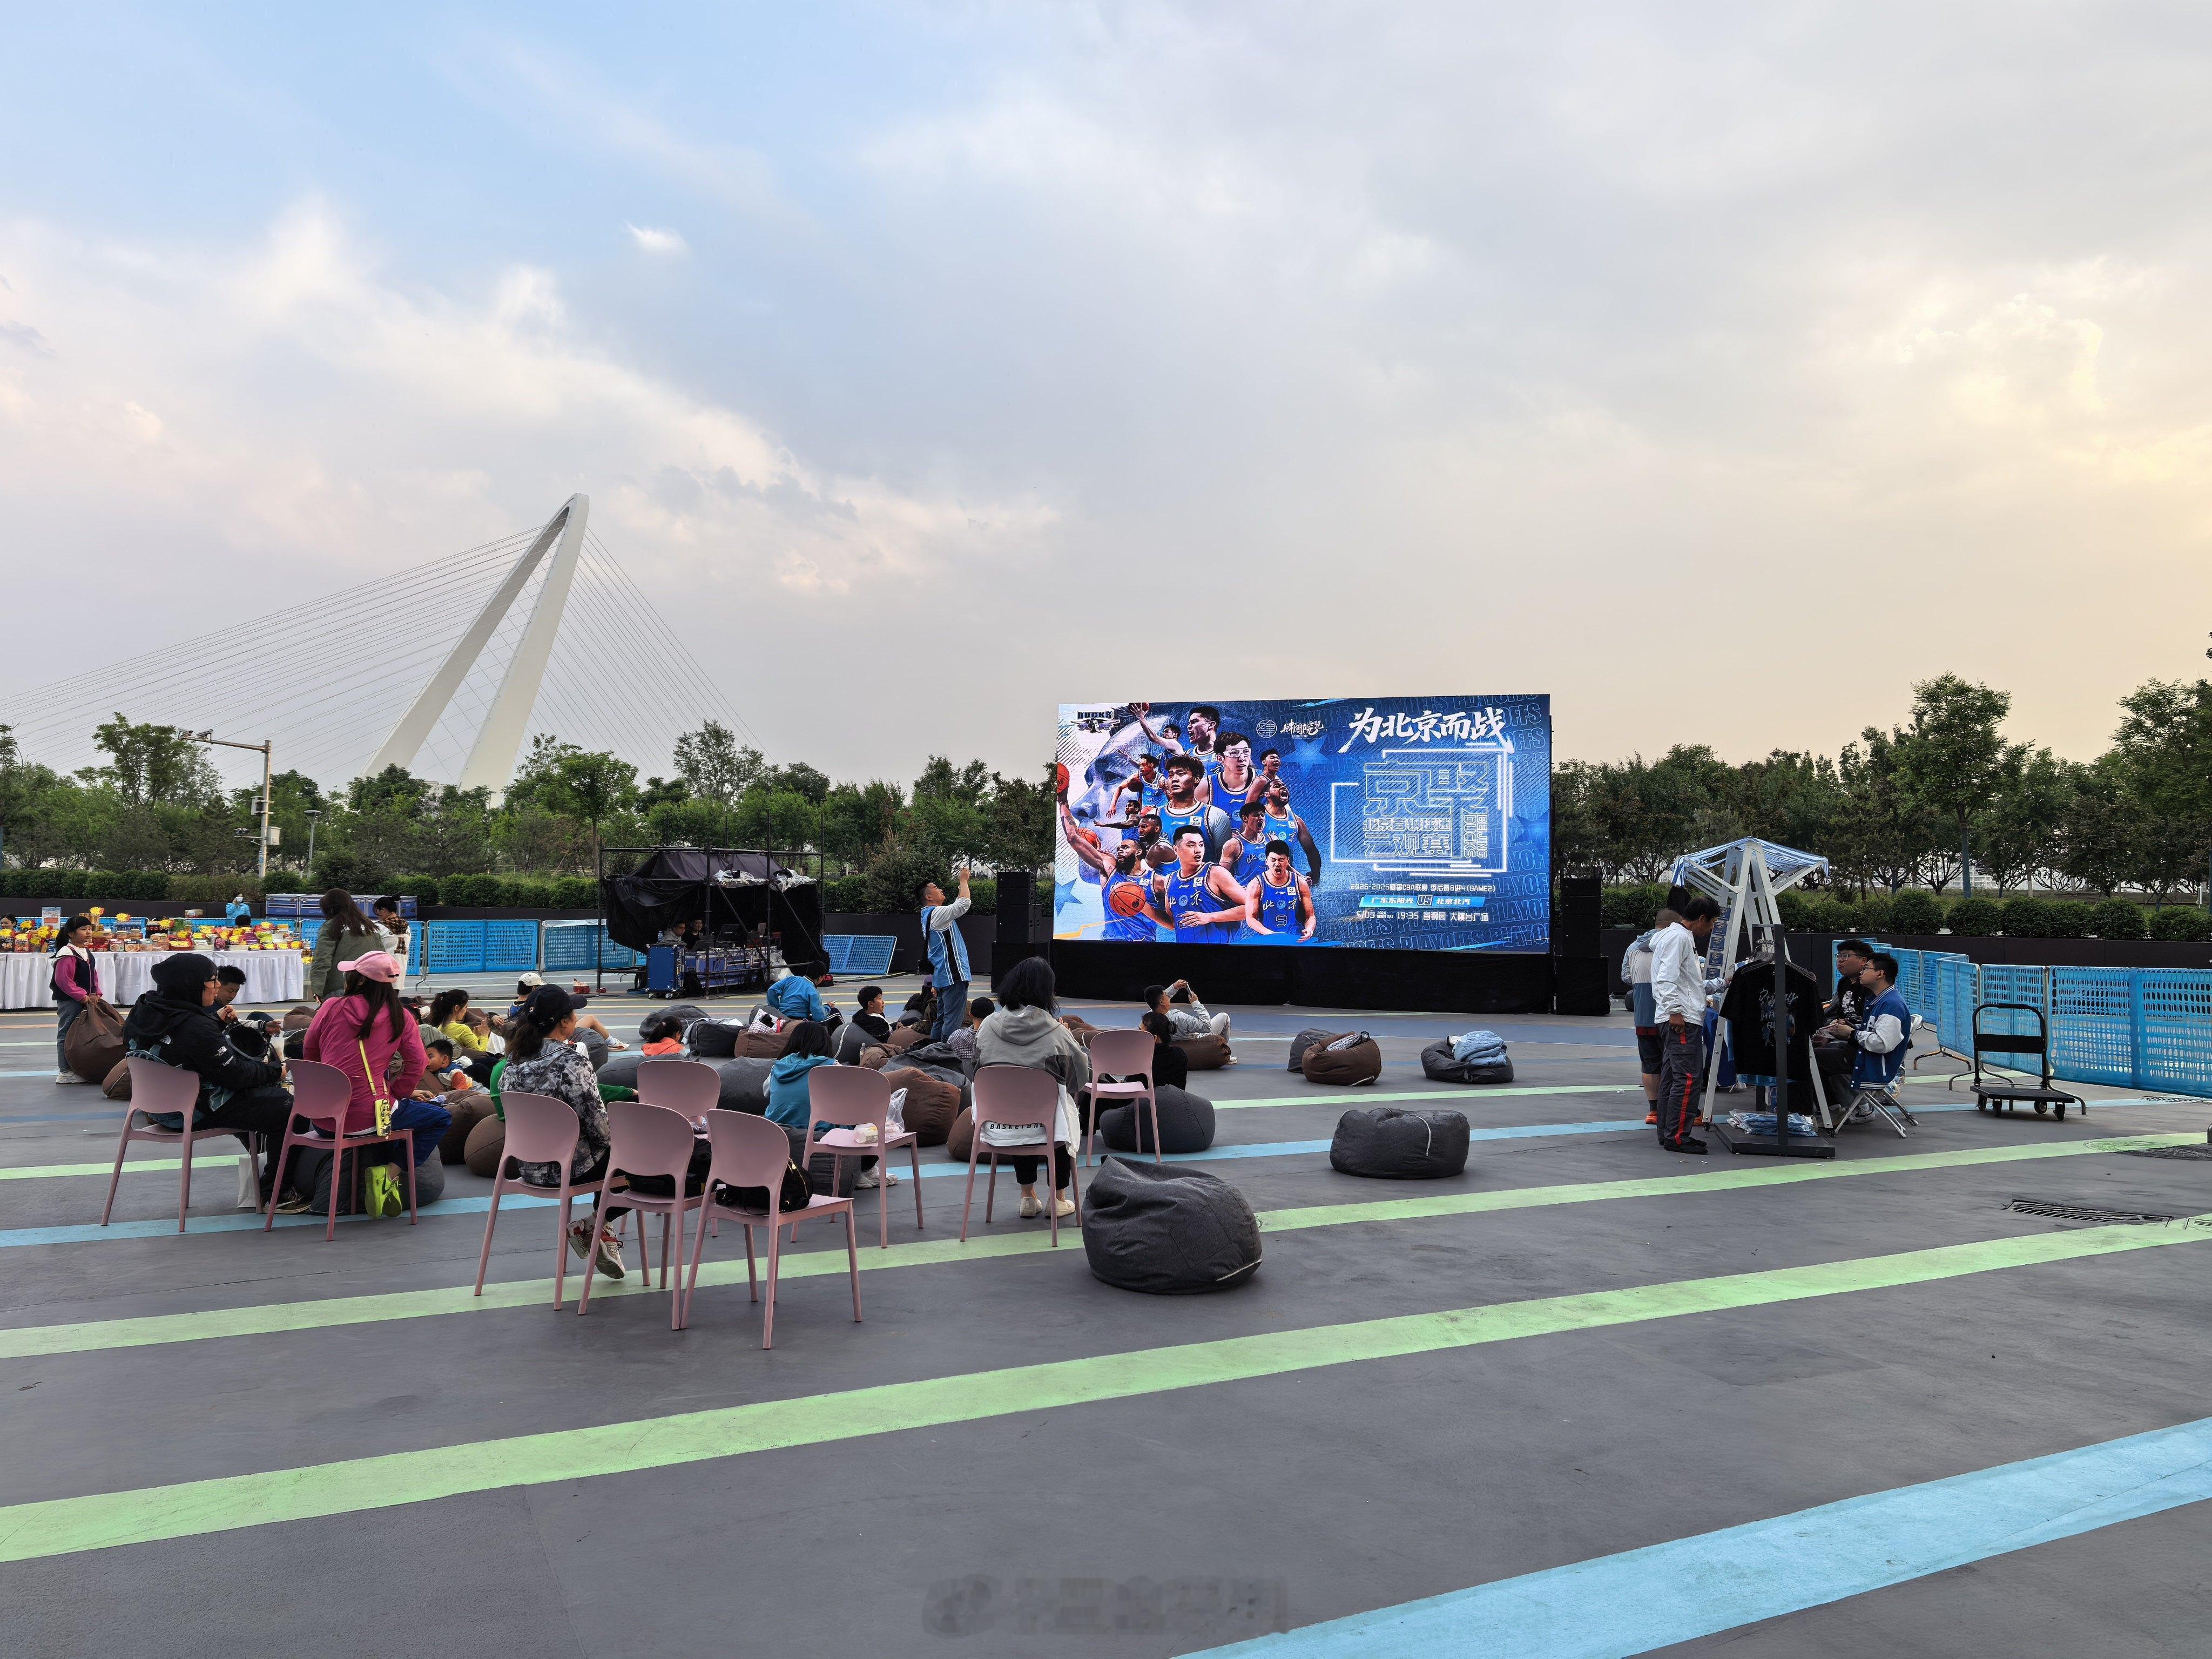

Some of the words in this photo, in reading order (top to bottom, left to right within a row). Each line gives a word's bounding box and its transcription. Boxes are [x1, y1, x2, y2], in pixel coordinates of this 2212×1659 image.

[1338, 707, 1515, 754] 为北京而战
[1363, 818, 1452, 832] 北京首钢球迷
[1464, 814, 1476, 858] DUCKS
[1476, 814, 1488, 858] BEIJING
[1364, 833, 1452, 858] 云观赛
[1356, 911, 1375, 919] 5/09
